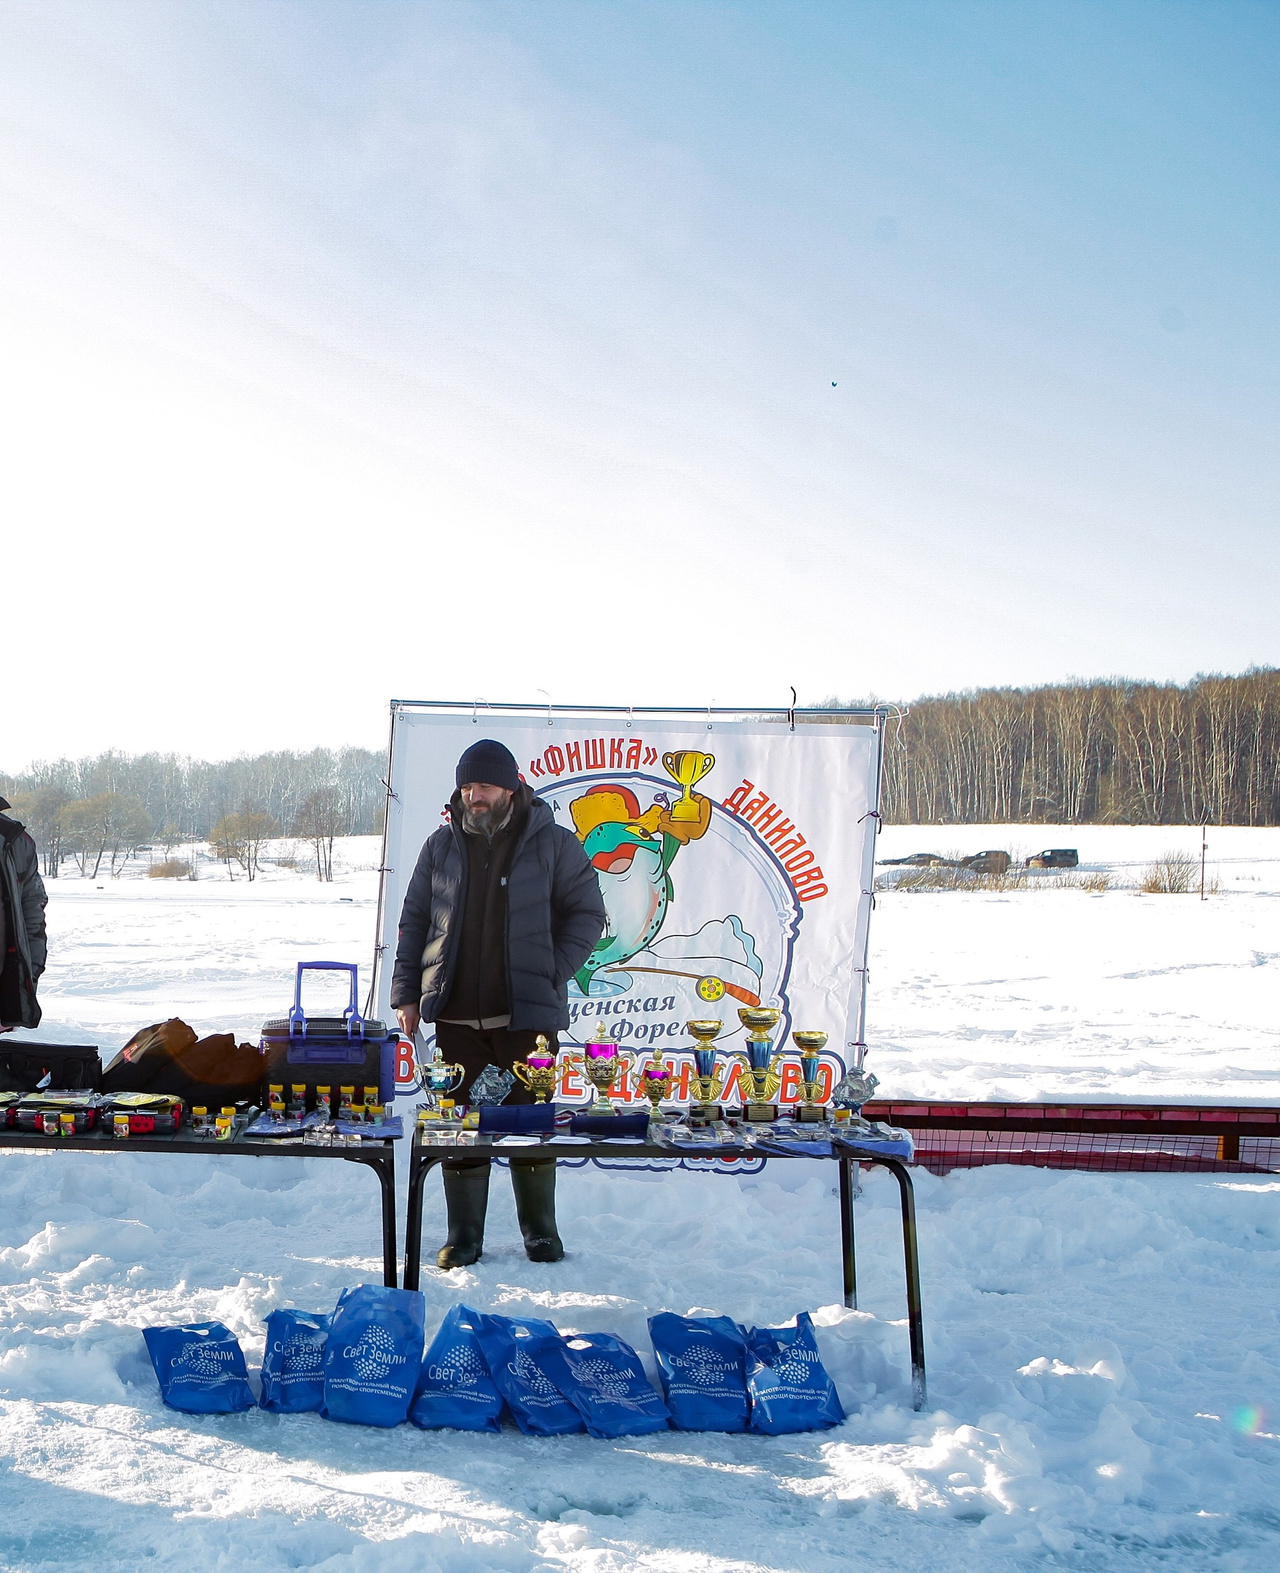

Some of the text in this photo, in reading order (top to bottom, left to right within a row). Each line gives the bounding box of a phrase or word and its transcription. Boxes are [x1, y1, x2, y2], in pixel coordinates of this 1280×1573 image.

[529, 738, 659, 778] «ФИШКА»
[721, 778, 829, 902] ДАНИЛОВО
[395, 1041, 415, 1083] В
[196, 1348, 235, 1361] Земли
[343, 1344, 407, 1365] Свет Земли
[668, 1354, 739, 1371] Свет Земли
[783, 1348, 821, 1363] Земли
[428, 1364, 456, 1381] Свет
[595, 1367, 636, 1383] Земли
[328, 1377, 408, 1394] БЛАГОТВОРИТЕЛЬНЫЙ ФОНД
[331, 1383, 403, 1399] ПОМОЩИ СПОРТСМЕНАМ
